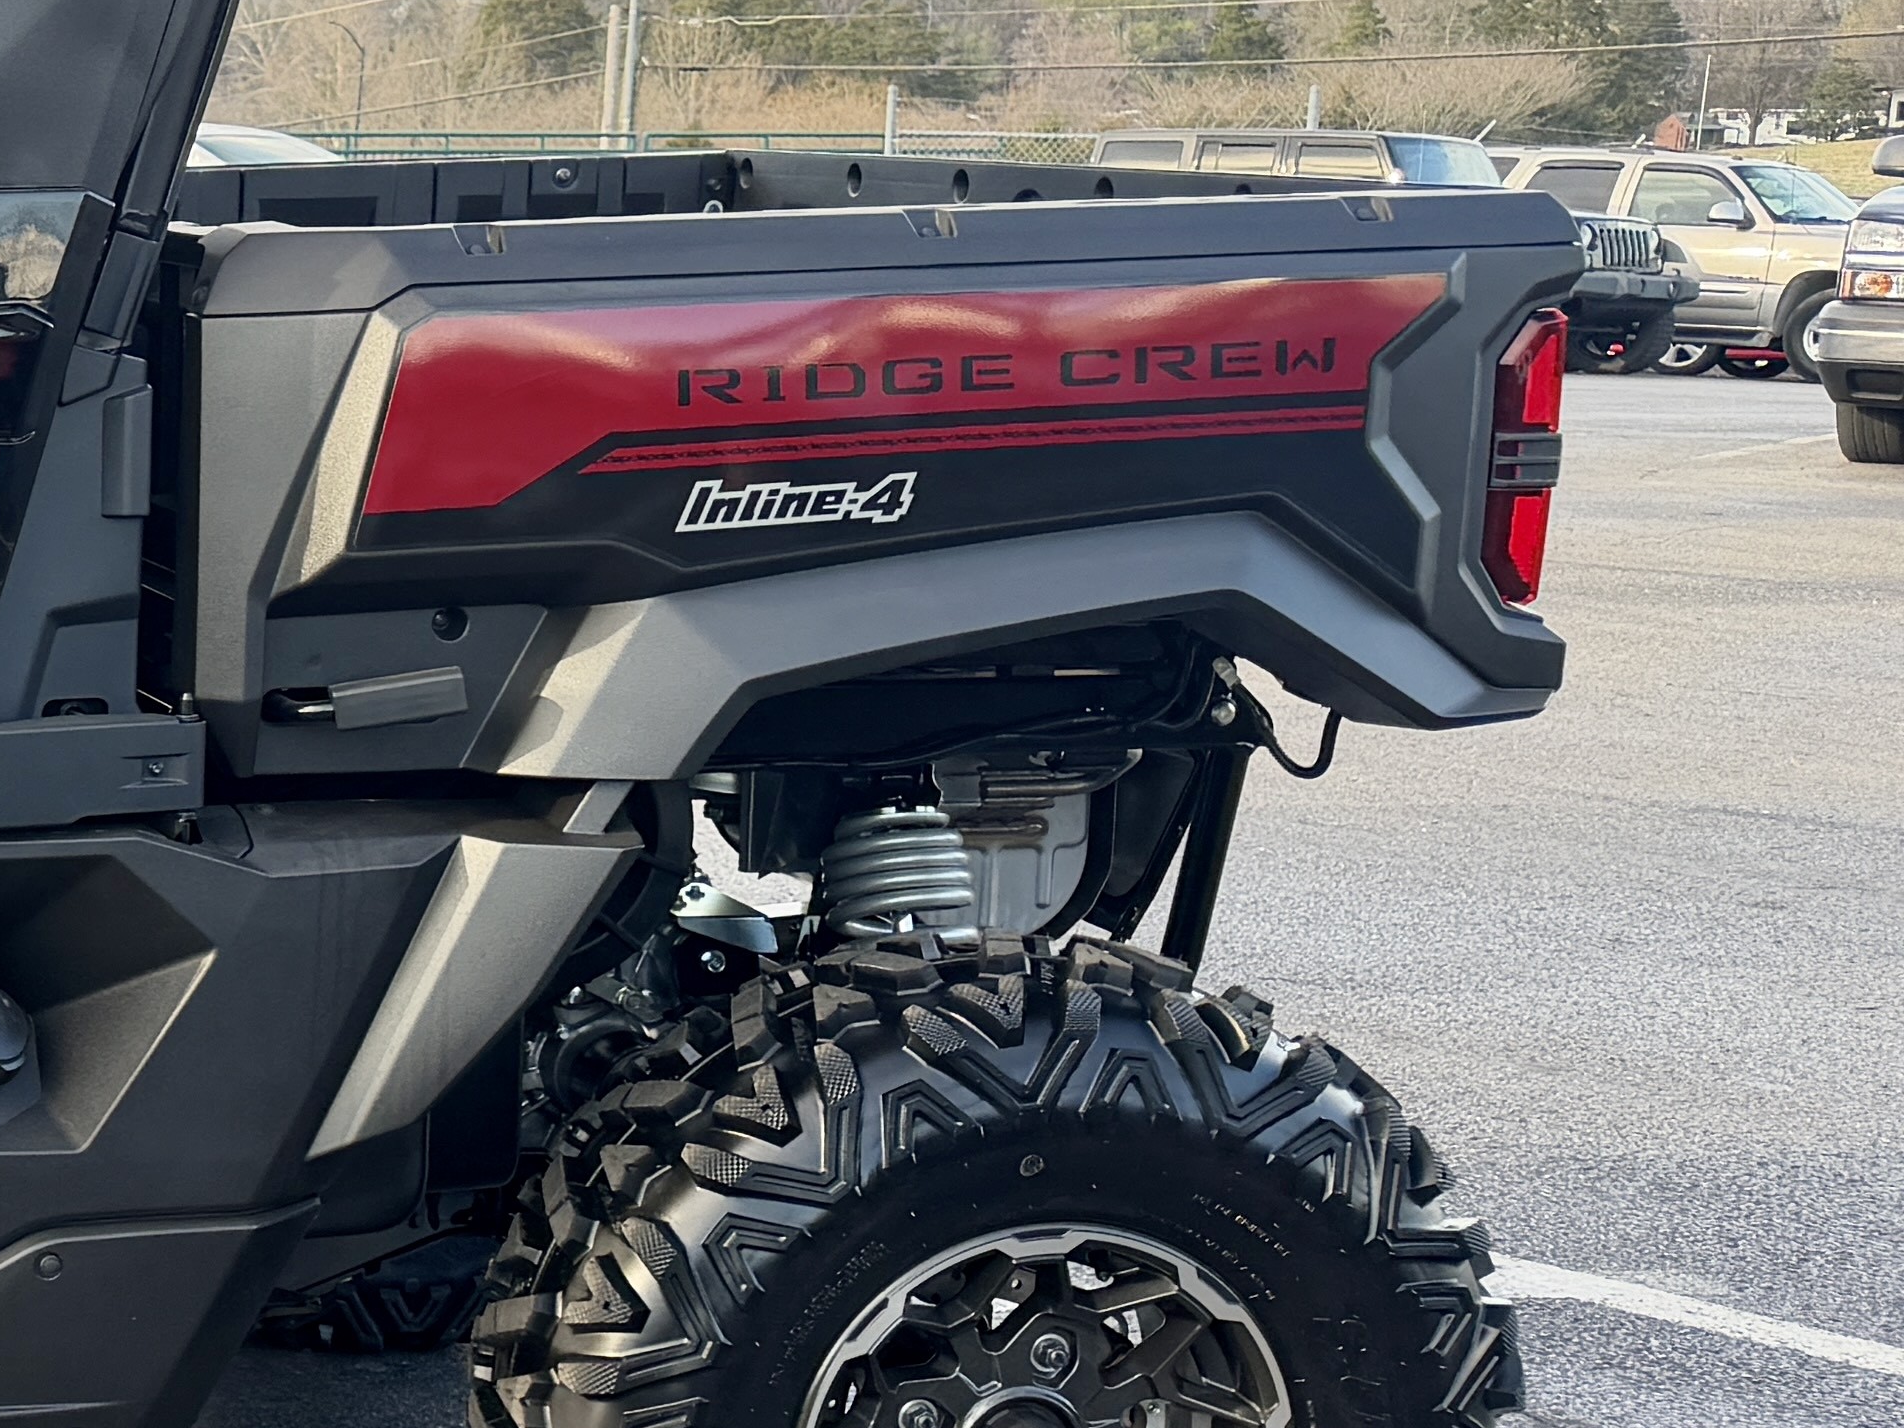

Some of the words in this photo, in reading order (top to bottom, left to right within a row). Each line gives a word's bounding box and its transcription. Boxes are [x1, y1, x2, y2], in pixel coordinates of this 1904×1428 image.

[677, 353, 1016, 407] RIDGE
[1060, 337, 1337, 388] CREW
[677, 472, 917, 531] Inline-4
